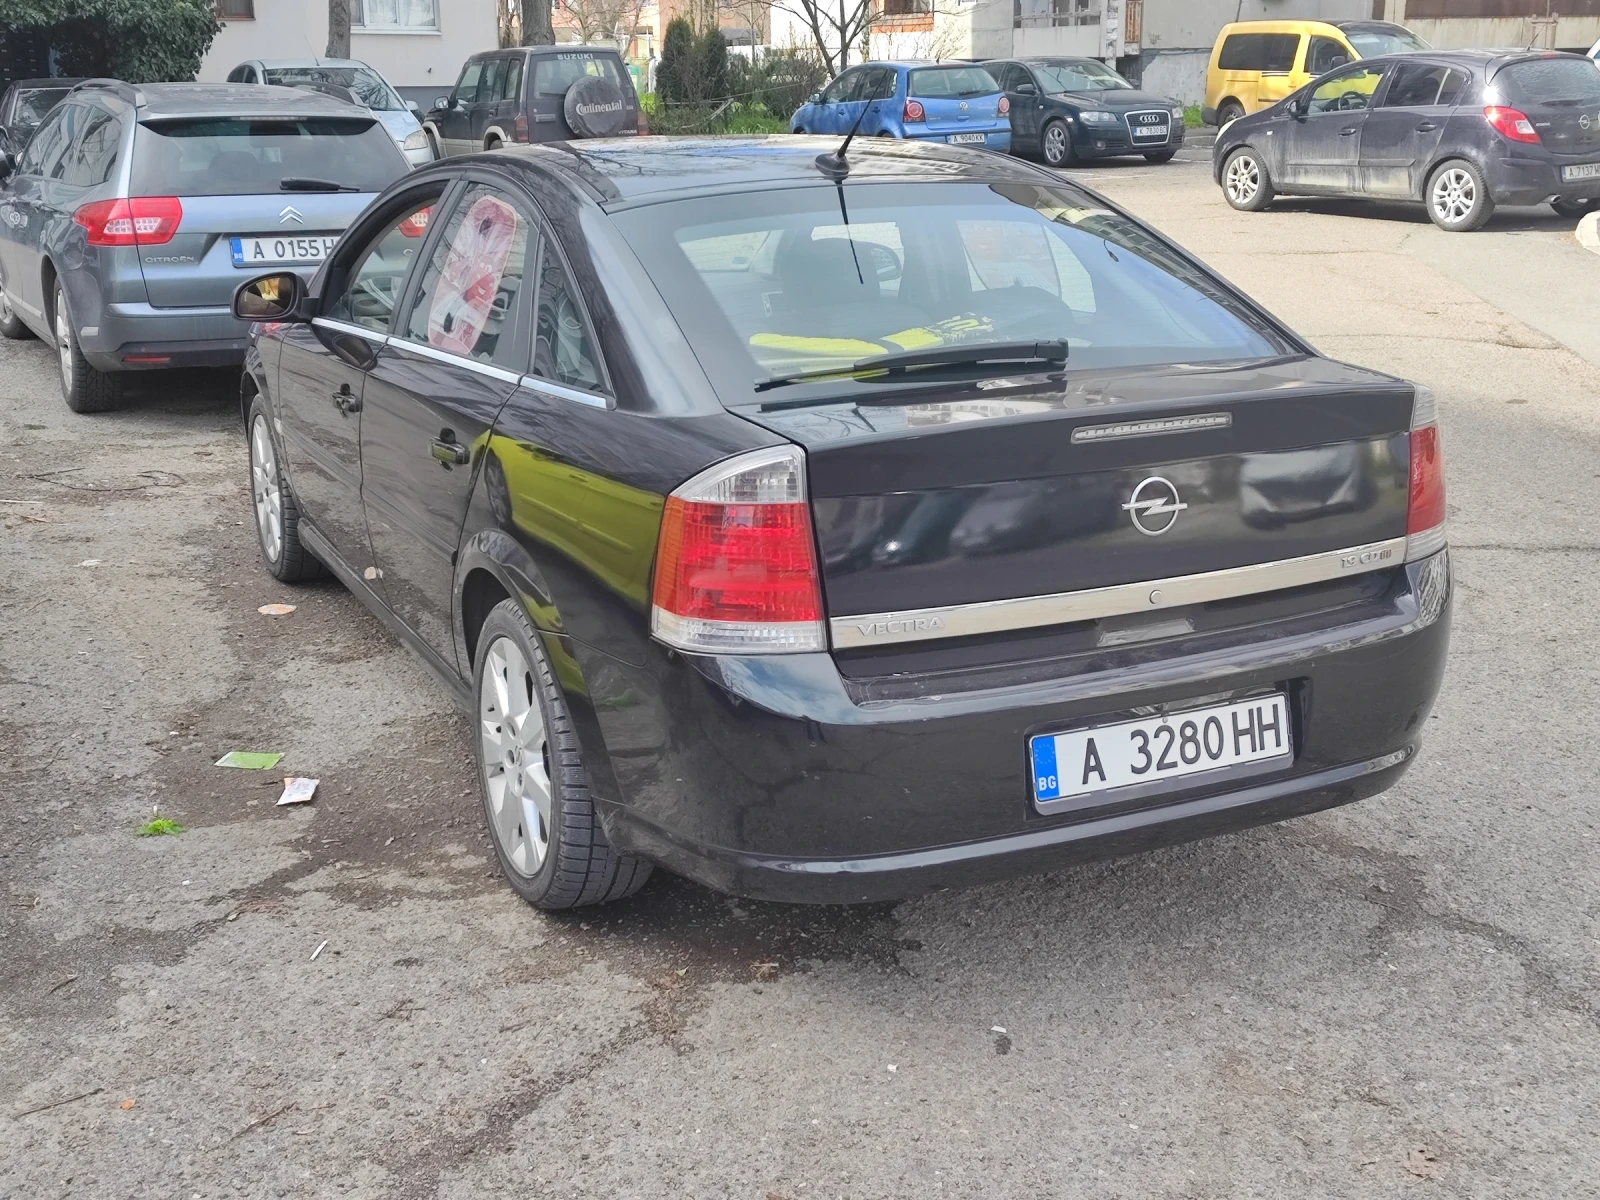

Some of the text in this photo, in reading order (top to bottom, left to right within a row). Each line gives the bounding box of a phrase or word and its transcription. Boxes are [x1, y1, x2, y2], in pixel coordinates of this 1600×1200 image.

[576, 100, 622, 115] Continental
[253, 239, 337, 259] A 0155H
[857, 617, 944, 637] VECTRA
[1082, 737, 1107, 785] A
[1038, 775, 1057, 791] BG
